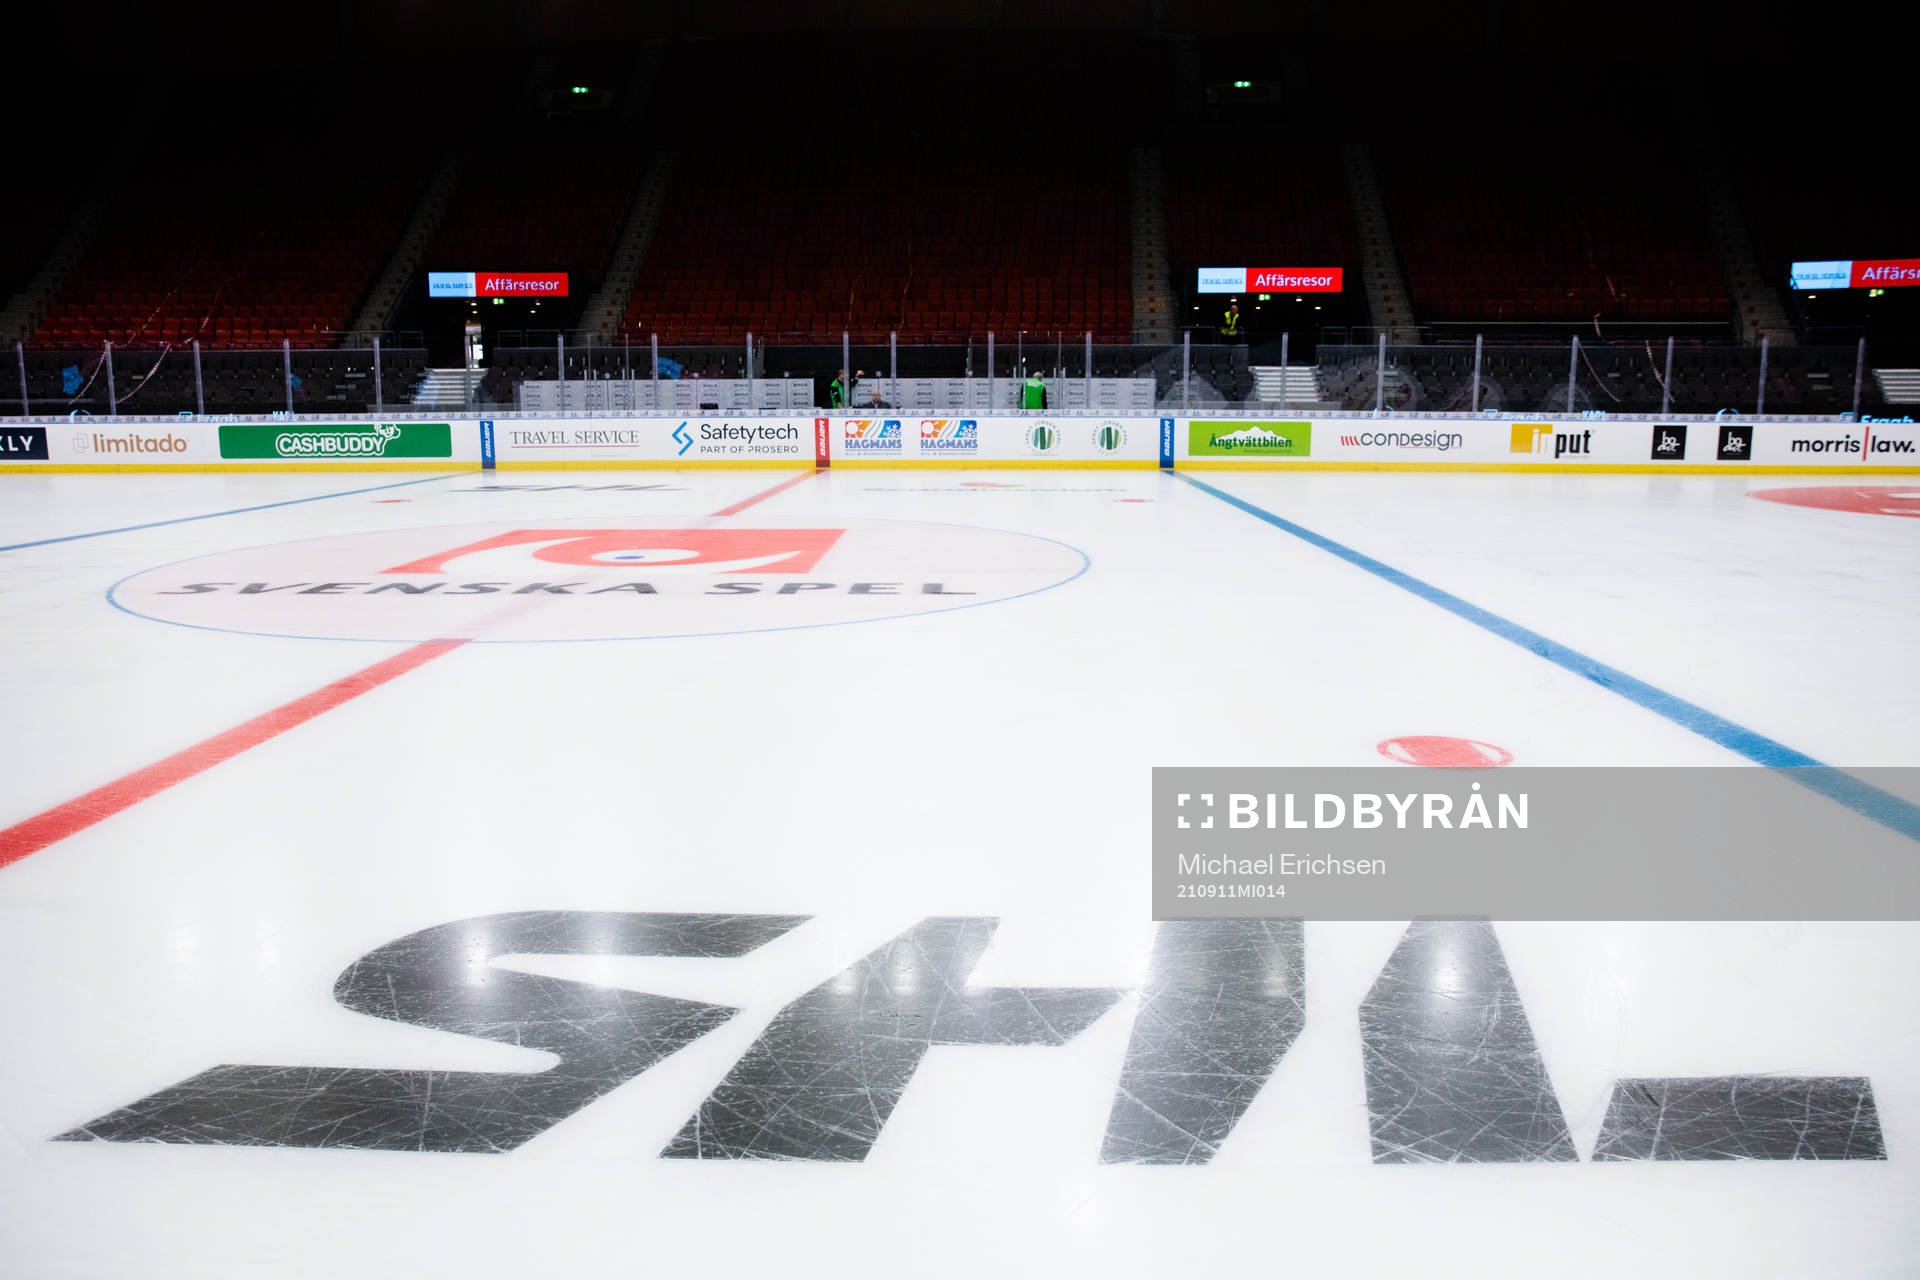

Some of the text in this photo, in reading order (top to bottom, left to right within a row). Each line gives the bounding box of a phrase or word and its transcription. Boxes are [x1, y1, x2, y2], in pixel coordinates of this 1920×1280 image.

[485, 278, 560, 291] Affärsresor
[1255, 274, 1333, 287] Affärsresor
[483, 421, 492, 458] BAUER
[510, 431, 640, 444] TRAVEL SERVICE
[700, 423, 799, 444] Safetytech
[818, 419, 826, 457] BAUER
[1163, 419, 1171, 457] BAUER
[1209, 433, 1292, 450] Ångtvättbilen
[93, 433, 188, 452] limitado
[277, 434, 386, 454] CASHBUDDY
[701, 445, 799, 453] PART OF PROSERO
[845, 439, 902, 449] HAGMANS
[920, 439, 978, 449] HAGMANS
[158, 581, 977, 596] SVENSKA SPEL
[48, 910, 1888, 1165] SHL
